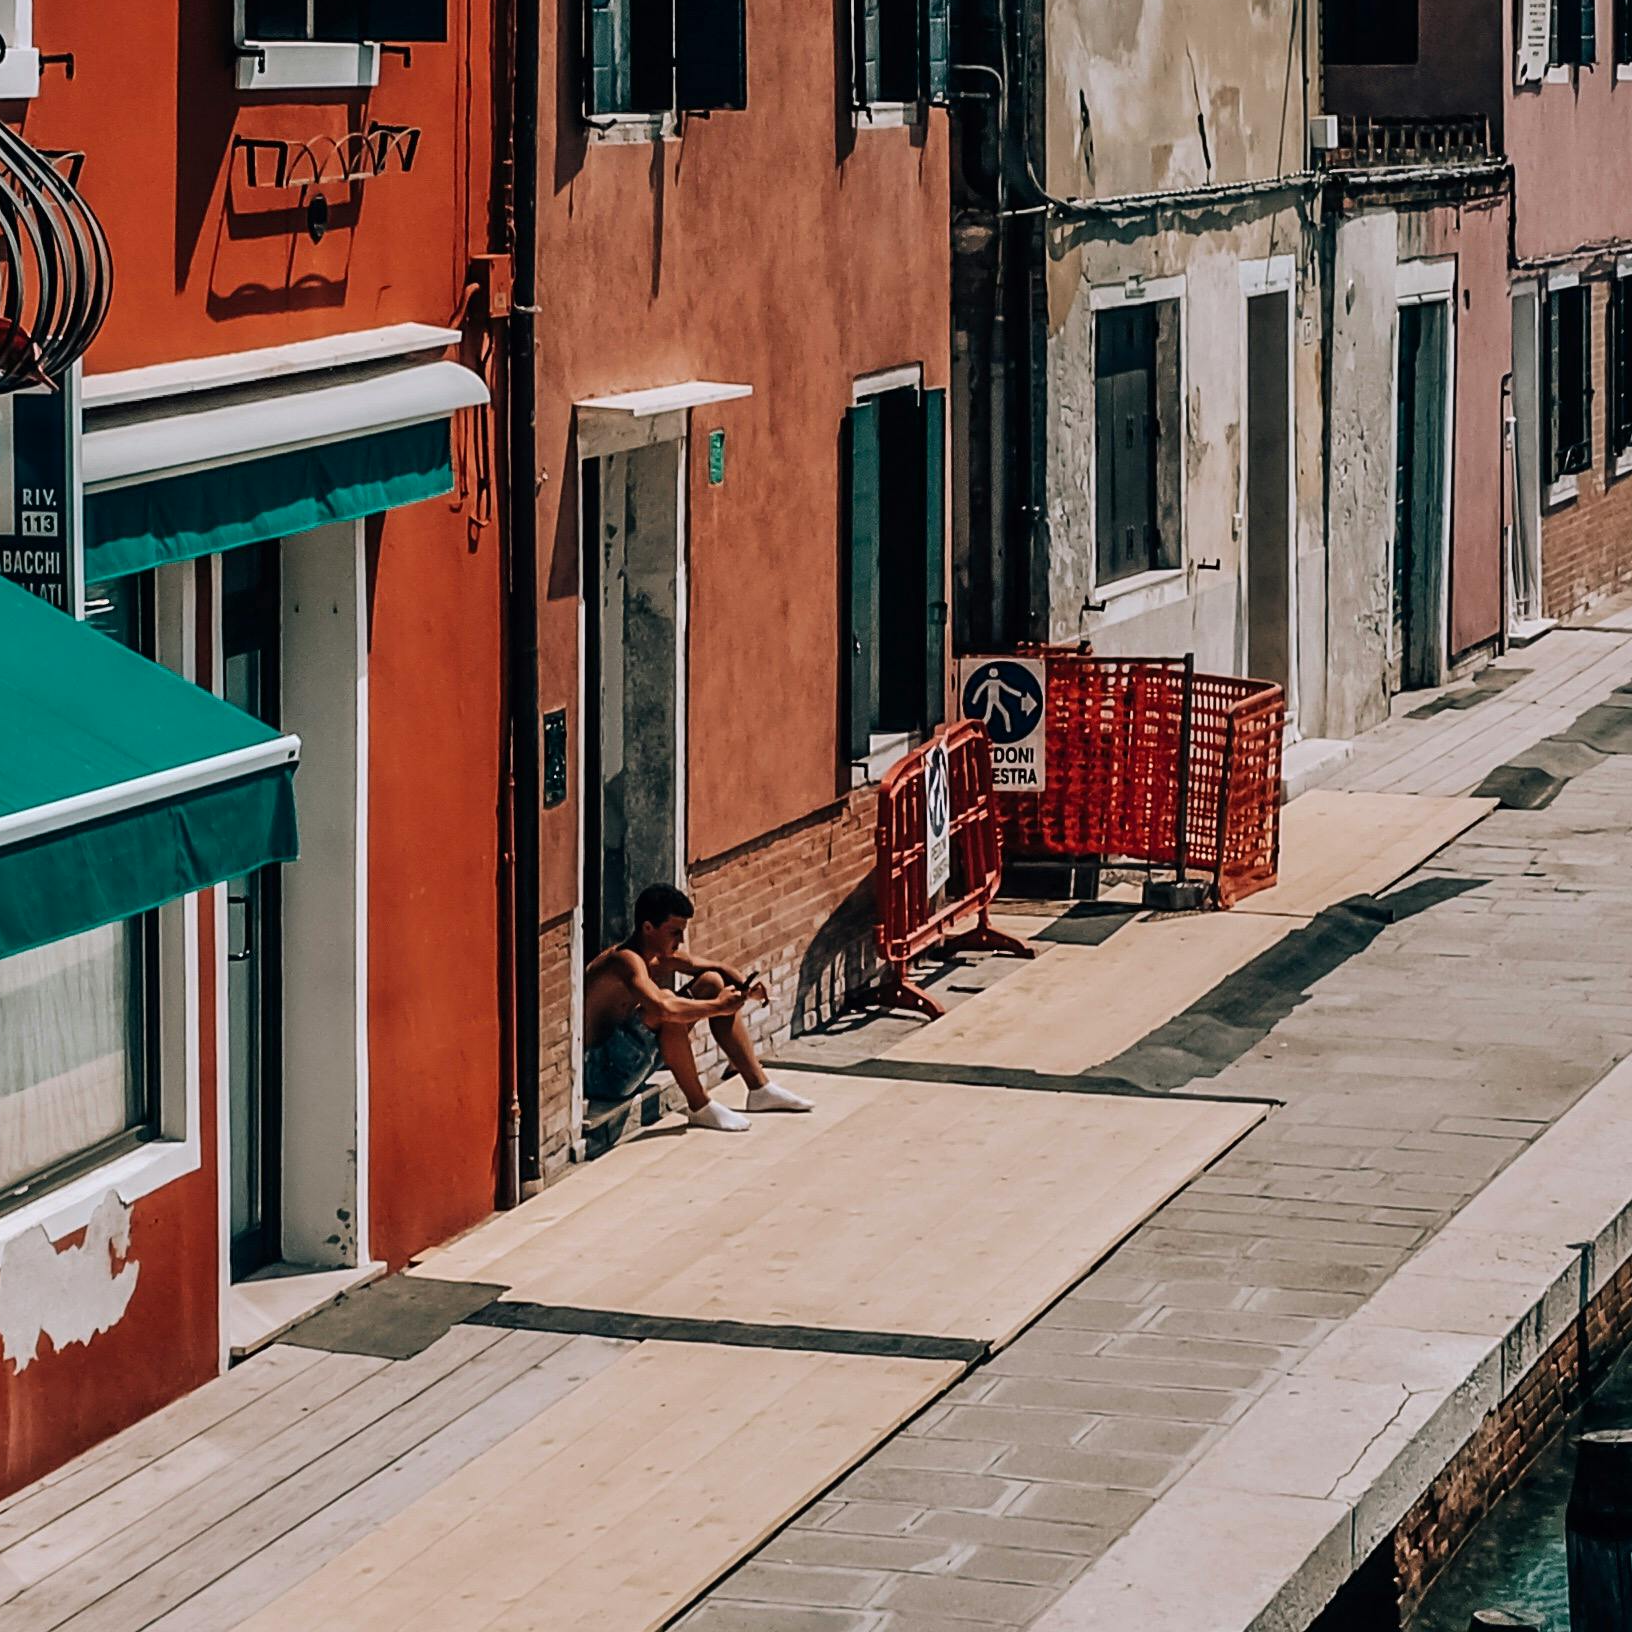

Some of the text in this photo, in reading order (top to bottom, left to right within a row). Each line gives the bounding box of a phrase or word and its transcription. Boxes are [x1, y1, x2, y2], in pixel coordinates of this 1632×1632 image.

[22, 488, 57, 506] RIV.
[23, 515, 55, 533] 113
[993, 747, 1034, 764] DONI
[992, 768, 1037, 784] ESTRA
